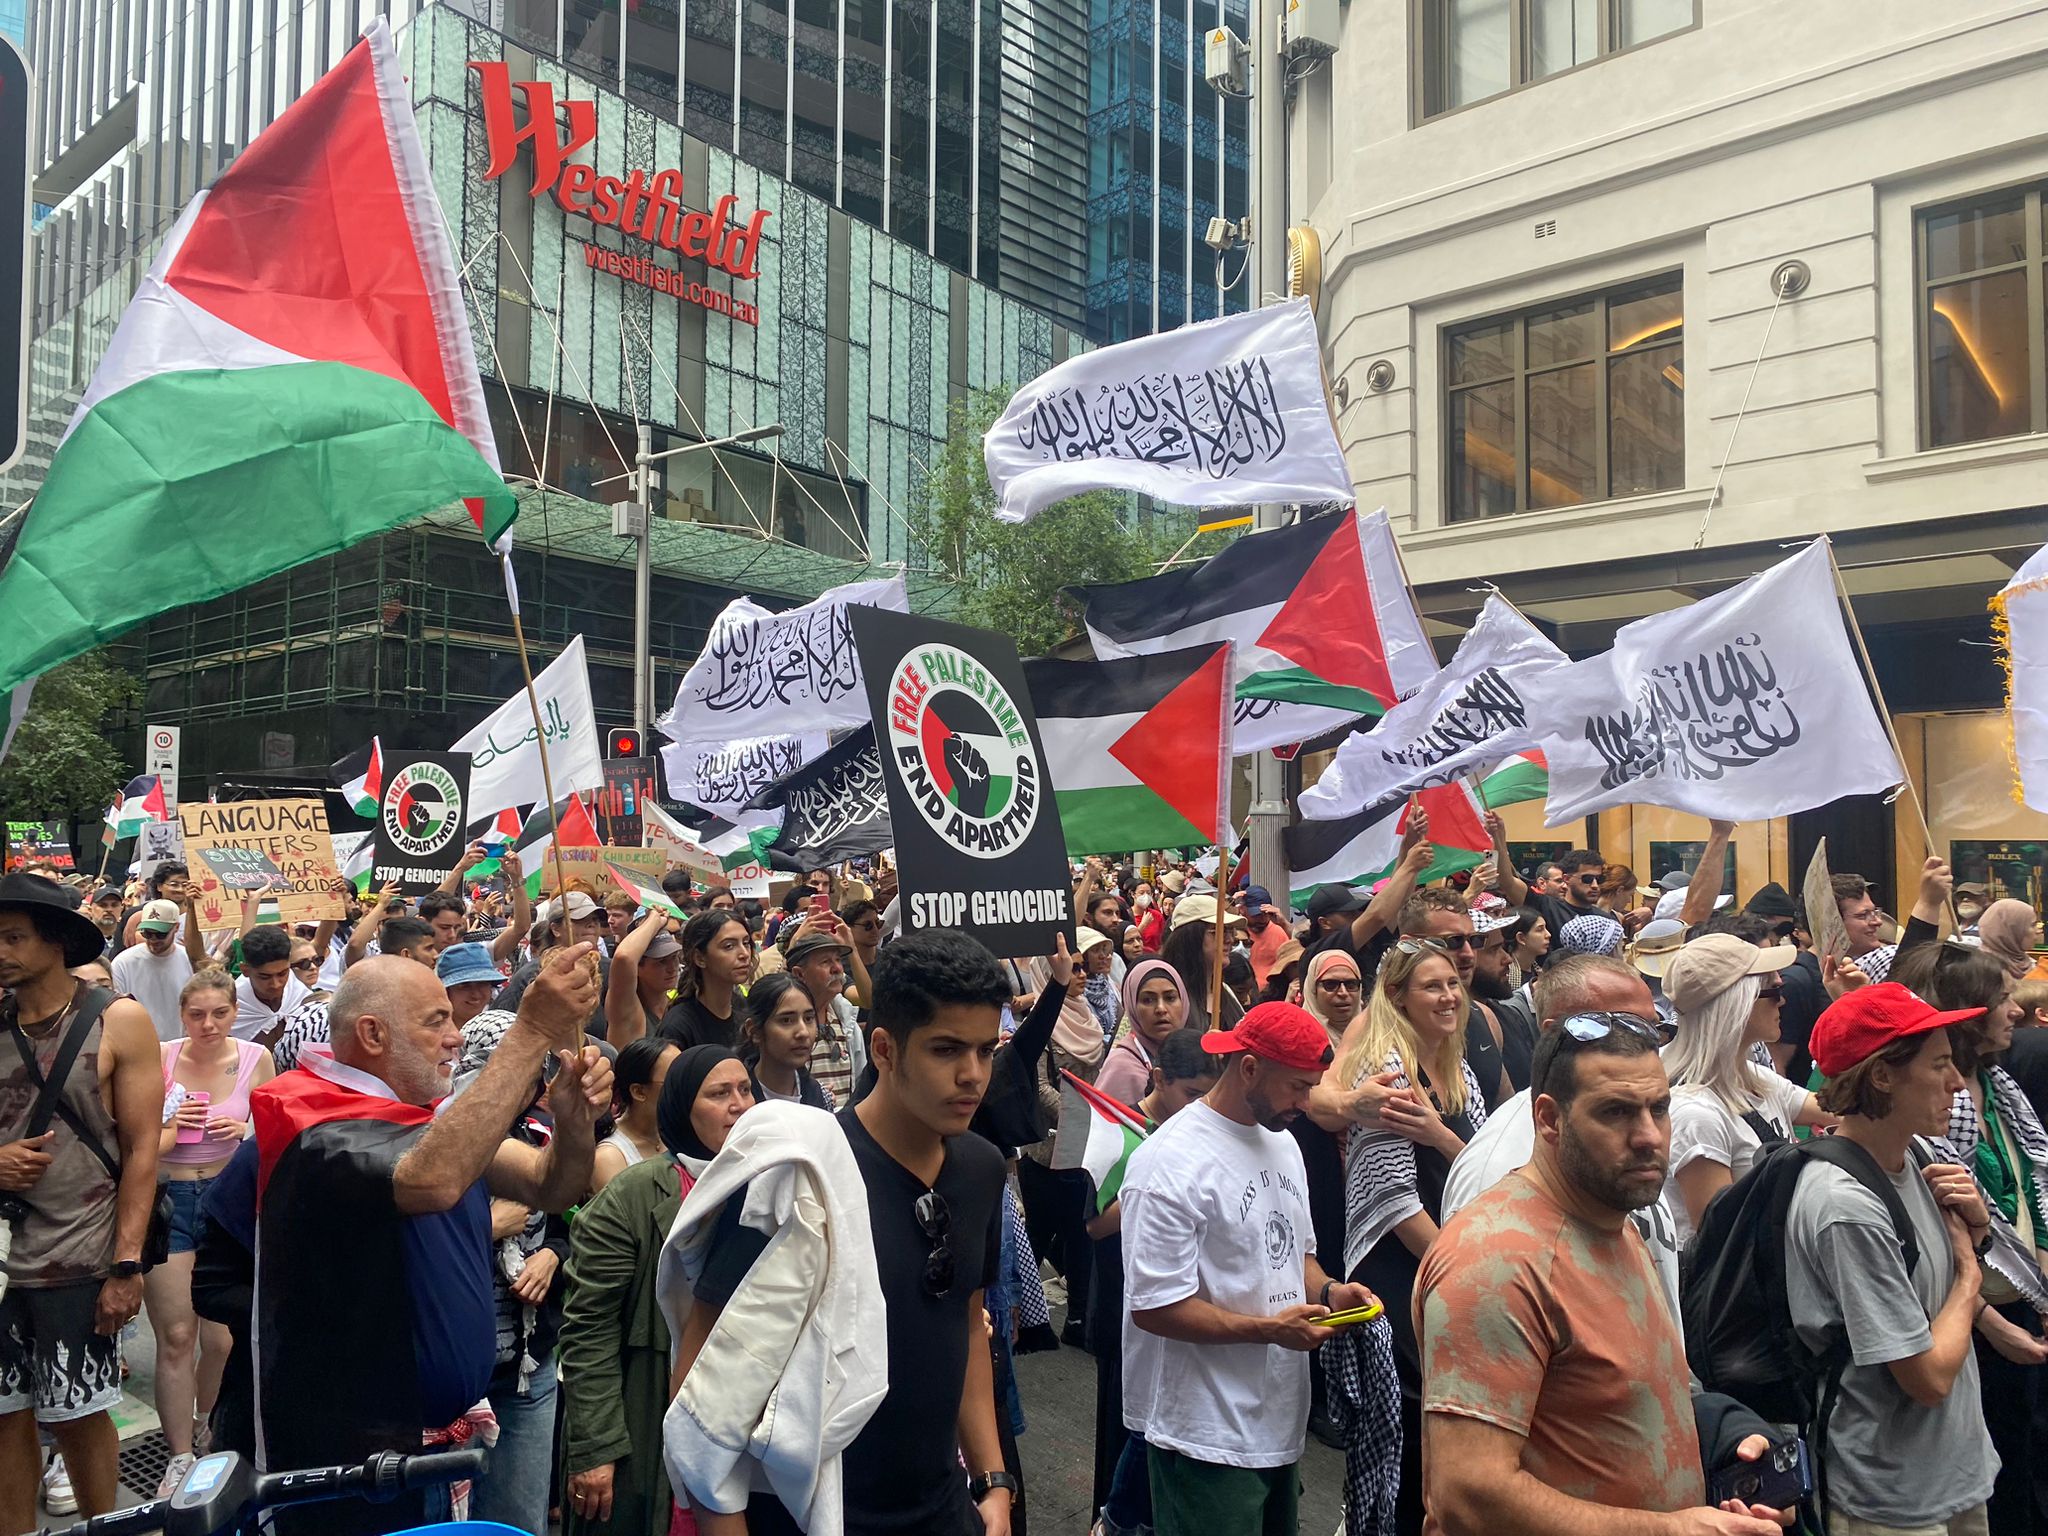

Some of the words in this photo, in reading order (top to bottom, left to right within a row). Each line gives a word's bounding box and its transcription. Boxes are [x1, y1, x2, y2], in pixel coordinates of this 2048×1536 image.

[466, 60, 772, 281] Westfield
[583, 242, 760, 326] westfield.com.au
[892, 663, 930, 737] FREE
[919, 650, 1028, 749] PALESTINE
[159, 736, 169, 744] 10
[387, 772, 411, 805] FREE
[410, 765, 459, 808] PALESTINE
[598, 777, 653, 817] chld
[897, 745, 946, 821] END
[948, 755, 1036, 852] APARTHEID
[181, 805, 329, 838] LANGUAGE
[385, 807, 402, 839] END
[400, 810, 457, 853] APARTHEID
[204, 848, 265, 863] STOP
[232, 862, 264, 871] THE
[374, 866, 404, 881] STOP
[405, 867, 453, 884] GENOCI
[911, 891, 967, 929] STOP
[971, 888, 1068, 926] GENOCIDE
[1239, 1179, 1257, 1224] LESS
[1259, 1169, 1270, 1188] IS
